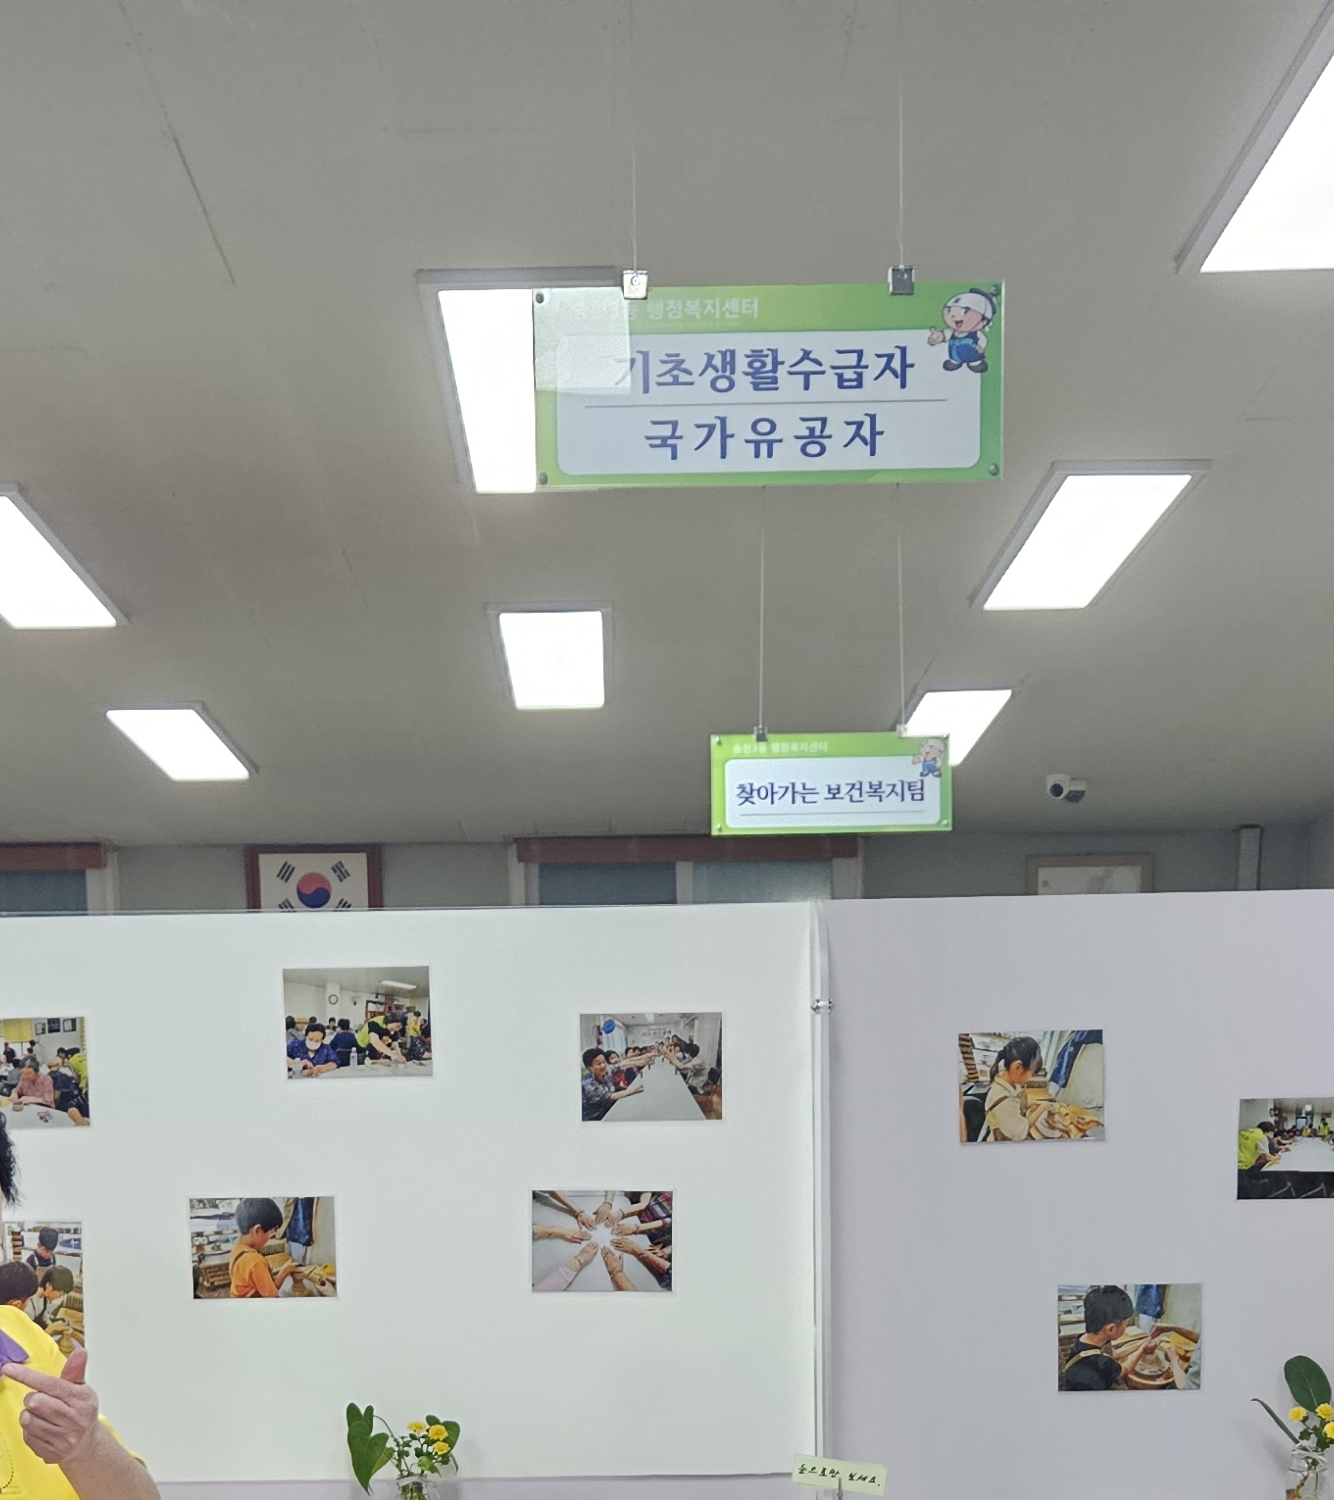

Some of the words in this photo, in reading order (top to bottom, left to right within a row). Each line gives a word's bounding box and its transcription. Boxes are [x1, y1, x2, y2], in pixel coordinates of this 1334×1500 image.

[646, 297, 759, 321] 행정복지센터
[615, 344, 916, 396] 기초생활수급자
[643, 412, 885, 461] 국가유공자
[736, 781, 820, 806] 찾아가는
[824, 779, 925, 803] 보건복지팀
